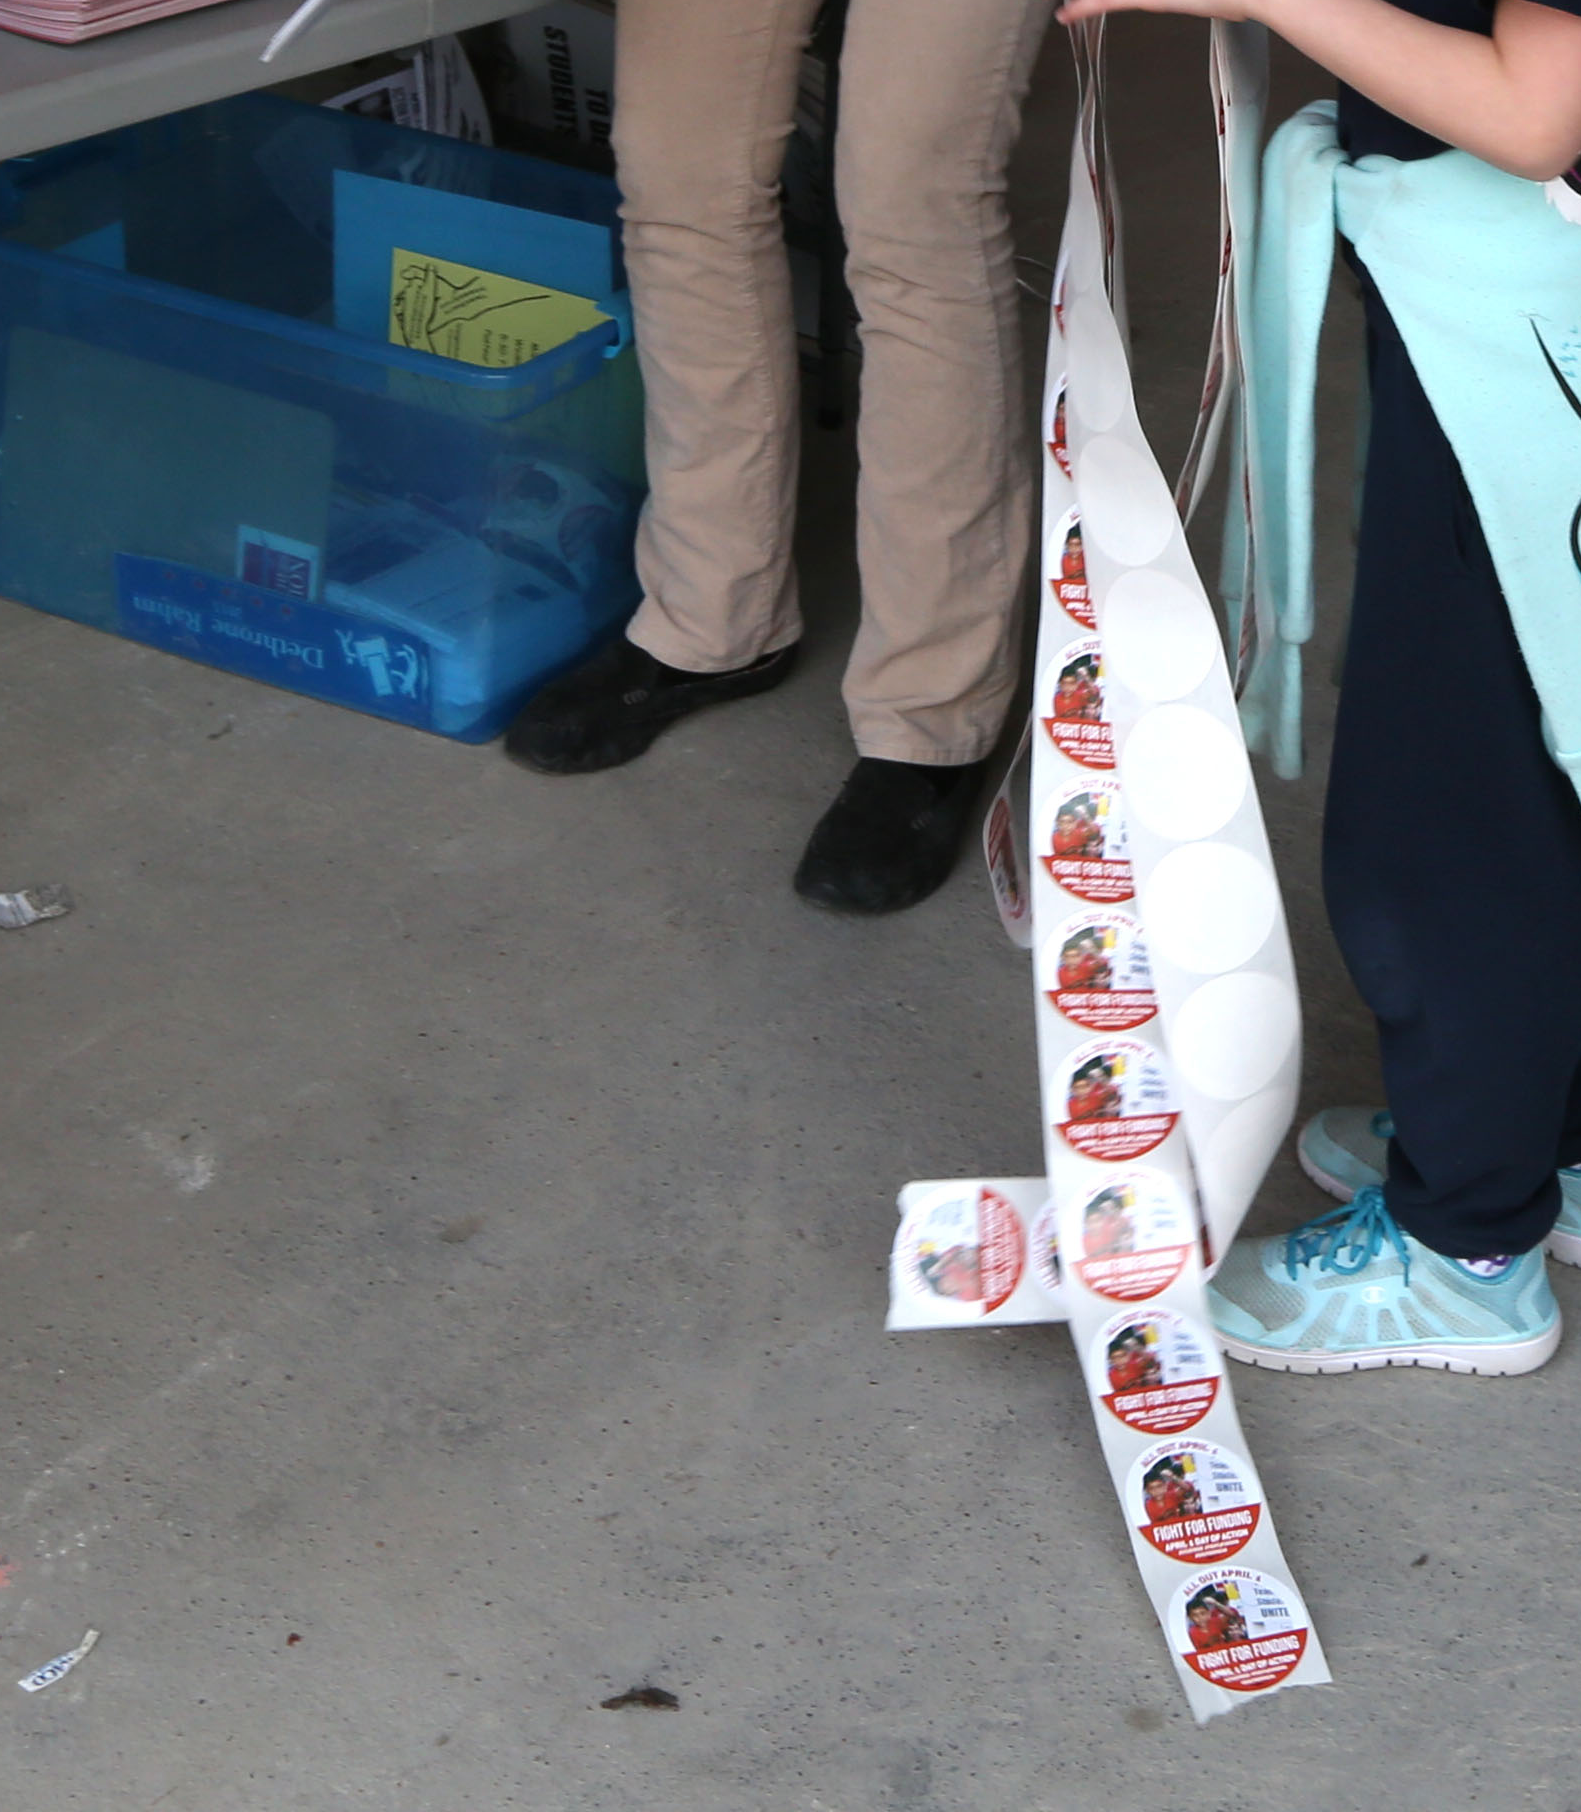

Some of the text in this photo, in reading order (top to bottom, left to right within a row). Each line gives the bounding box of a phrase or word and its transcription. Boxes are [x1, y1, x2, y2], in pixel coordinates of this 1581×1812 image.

[132, 595, 324, 669] Dethrone Rahm
[1215, 1481, 1244, 1492] UNITE
[1153, 1509, 1253, 1543] FIGHT FOR FUNDING
[1183, 1582, 1199, 1597] ALL
[1198, 1572, 1219, 1584] OUT
[1221, 1569, 1252, 1580] APRIL
[1260, 1607, 1290, 1617] UNITE
[1196, 1635, 1300, 1671] FIGHT FOR FUNDING
